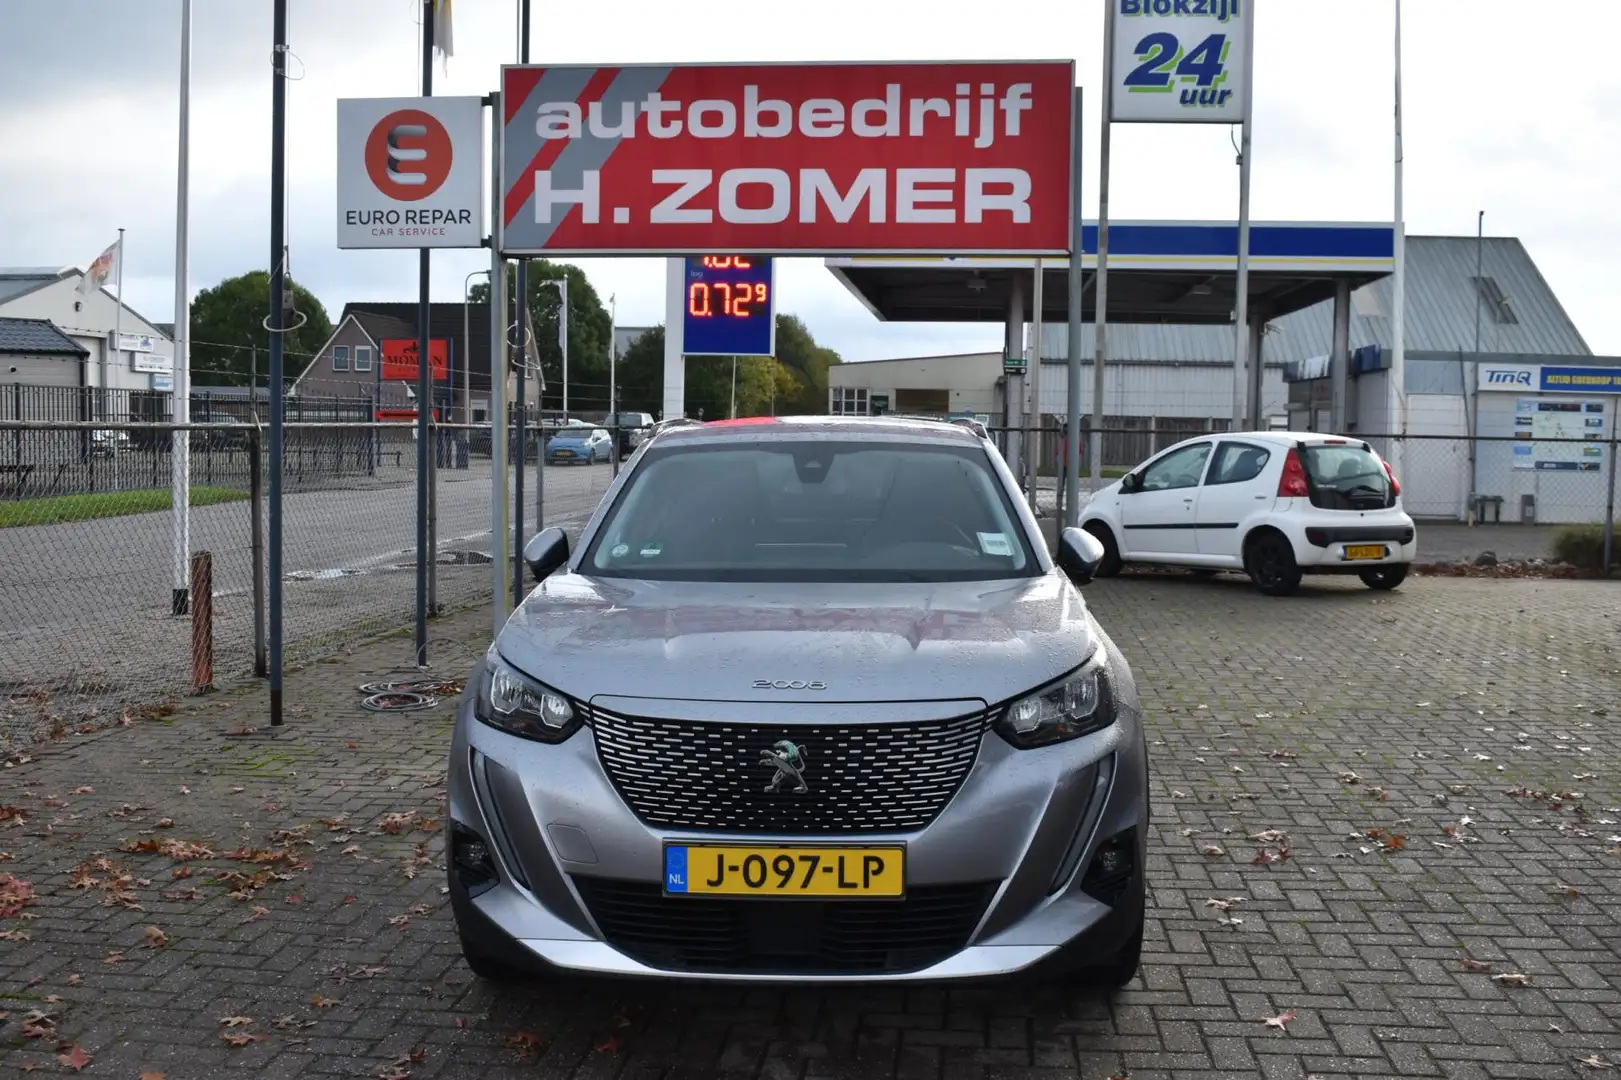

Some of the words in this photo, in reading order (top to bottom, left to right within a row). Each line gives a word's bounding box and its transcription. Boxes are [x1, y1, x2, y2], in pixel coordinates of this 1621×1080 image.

[1123, 32, 1229, 89] 24
[1179, 89, 1232, 107] uur
[535, 82, 1033, 149] autobedrijf
[534, 169, 630, 224] H.
[650, 167, 1033, 224] ZOMER
[346, 209, 400, 225] EURO
[405, 208, 471, 225] REPAR
[371, 228, 393, 237] CAR
[399, 227, 446, 237] SERVICE
[387, 355, 443, 366] MOMN
[752, 679, 828, 691] 2008
[669, 873, 684, 884] NL
[706, 853, 885, 889] J-097-LP
